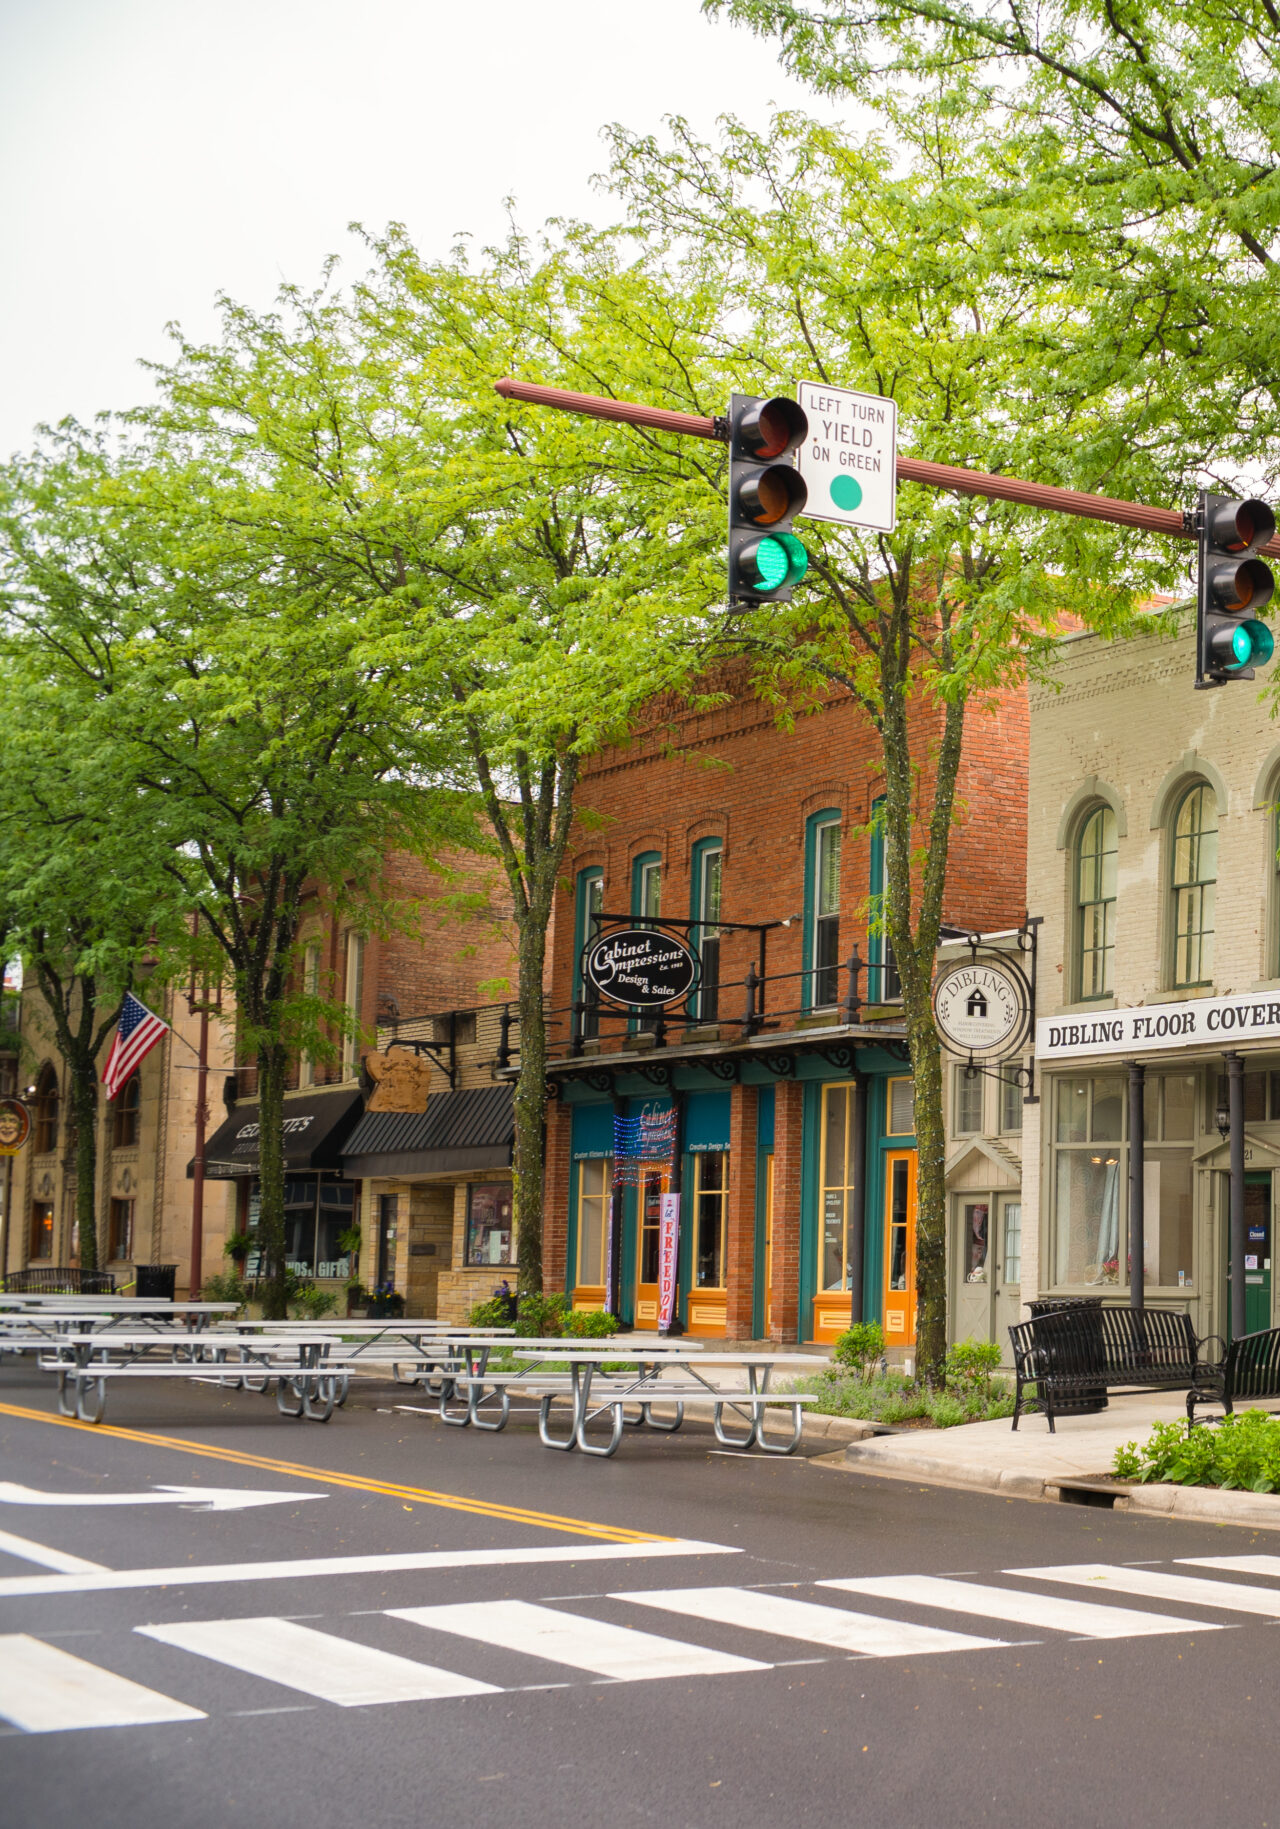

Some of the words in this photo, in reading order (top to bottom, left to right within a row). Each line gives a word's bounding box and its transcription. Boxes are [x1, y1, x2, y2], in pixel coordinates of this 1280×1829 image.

[811, 395, 842, 414] LEFT
[851, 404, 884, 424] TURN
[823, 420, 872, 447] YIELD
[813, 446, 830, 462] ON
[840, 451, 881, 472] GREEN
[594, 940, 652, 970] Cabinet
[599, 949, 684, 985] Impressions
[618, 974, 648, 987] Design
[641, 984, 650, 994] &
[651, 985, 676, 995] Sales
[946, 971, 1010, 1001] DIBLING
[1048, 1021, 1124, 1047] DIBLING
[1133, 1012, 1196, 1039] FLOOR
[319, 1261, 349, 1277] GIFTS
